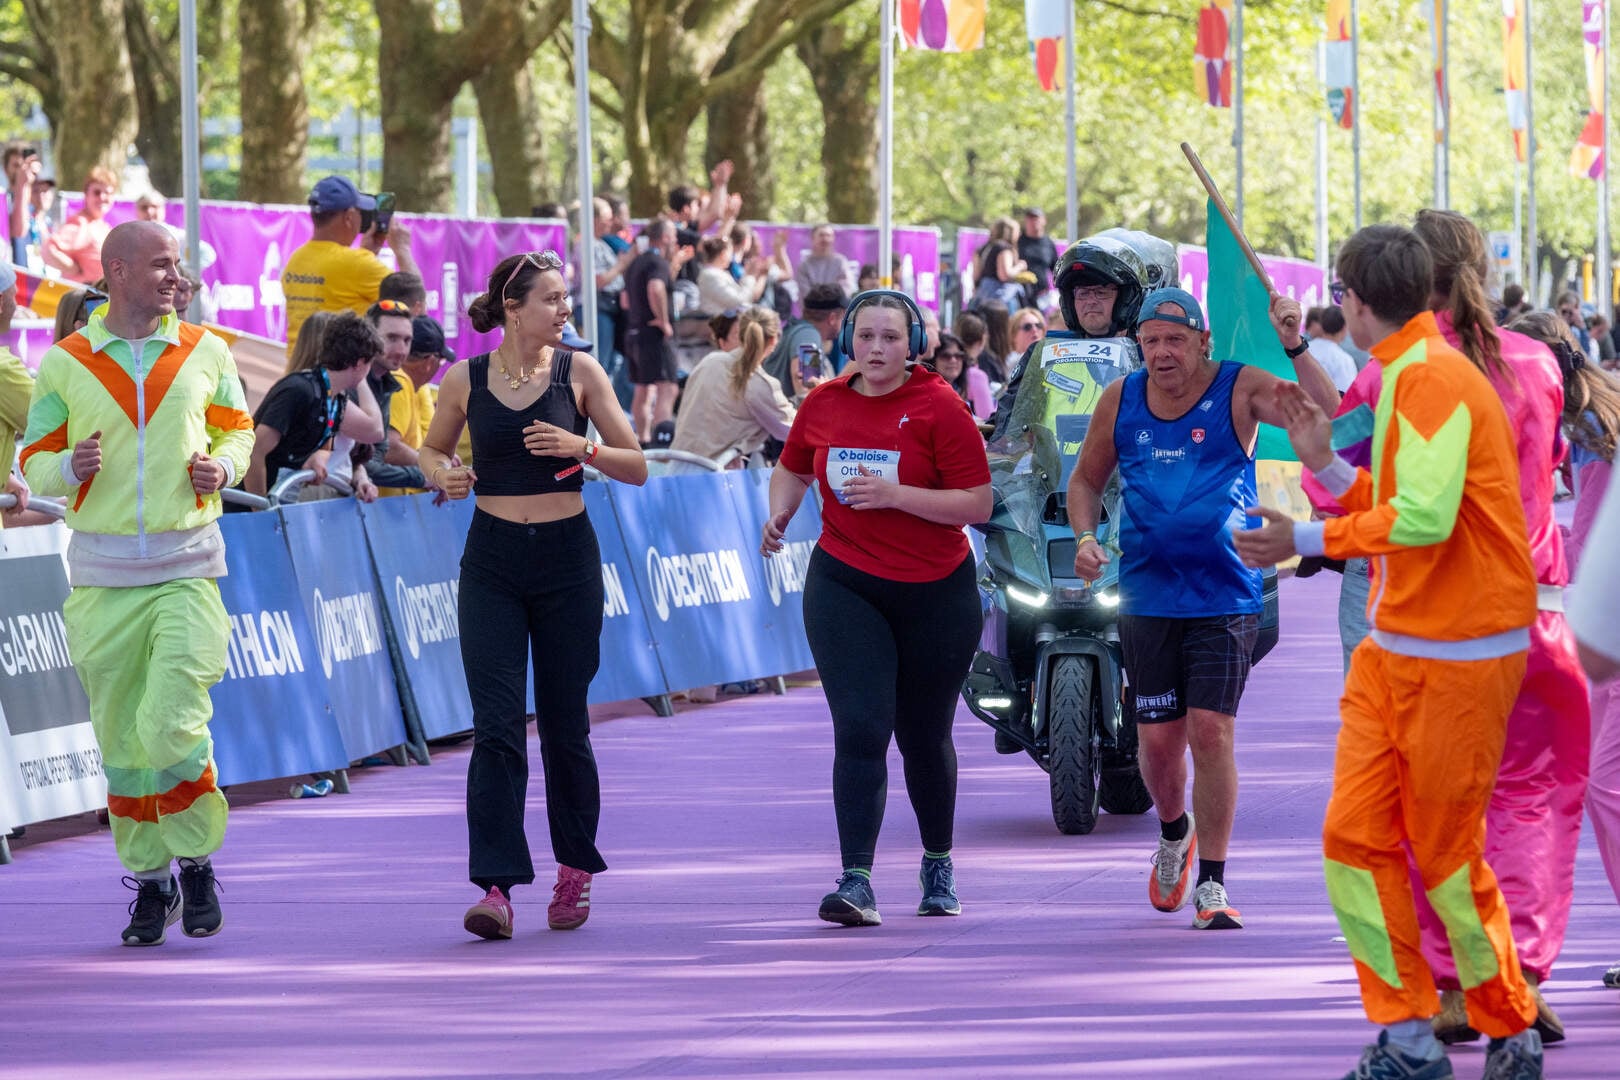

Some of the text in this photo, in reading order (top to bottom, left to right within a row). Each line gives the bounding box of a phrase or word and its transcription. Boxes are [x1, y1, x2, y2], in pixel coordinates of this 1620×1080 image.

[1088, 344, 1112, 357] 24
[1055, 356, 1104, 364] ORGANISATION
[849, 450, 889, 461] baloise
[840, 465, 883, 476] Otten
[661, 549, 751, 608] DECATHLON
[324, 591, 382, 662] DECATHLON
[0, 611, 74, 677] GARMIN
[1136, 694, 1173, 709] ANTWERP
